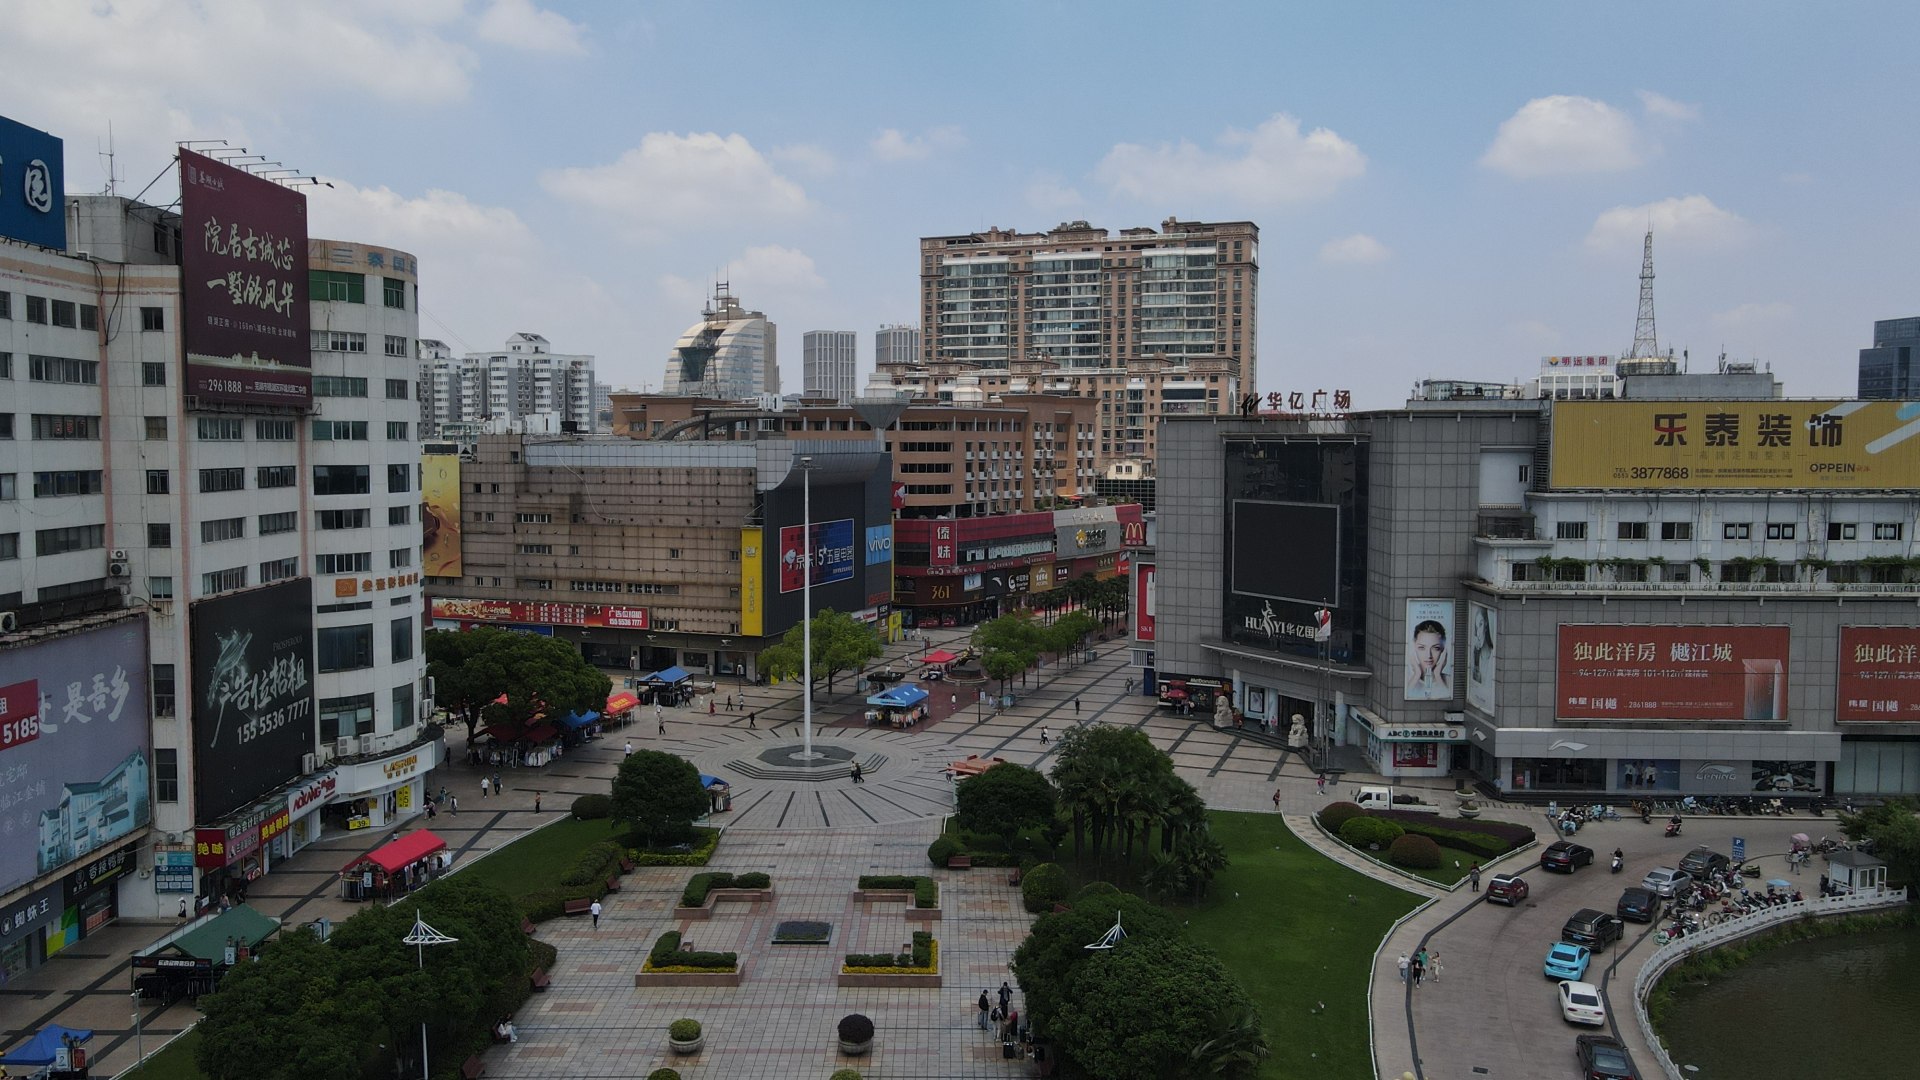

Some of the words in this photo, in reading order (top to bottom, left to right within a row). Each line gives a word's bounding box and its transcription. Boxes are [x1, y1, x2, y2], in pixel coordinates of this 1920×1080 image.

[1561, 356, 1608, 367] 明远集团
[208, 378, 242, 393] 2961888
[1267, 389, 1351, 411] 华亿广场
[1654, 413, 1843, 447] 乐泰装饰
[1630, 467, 1689, 479] 3877868
[1809, 463, 1856, 473] OPPEIN
[827, 545, 853, 566] 五星电器
[1573, 642, 1657, 662] 独此洋房
[1855, 644, 1920, 664] 独此洋
[211, 651, 308, 749] 广告位招租
[237, 719, 257, 745] 155
[259, 708, 285, 736] 5536
[286, 696, 310, 723] 7777
[14, 897, 50, 929] 蜘蛛王
